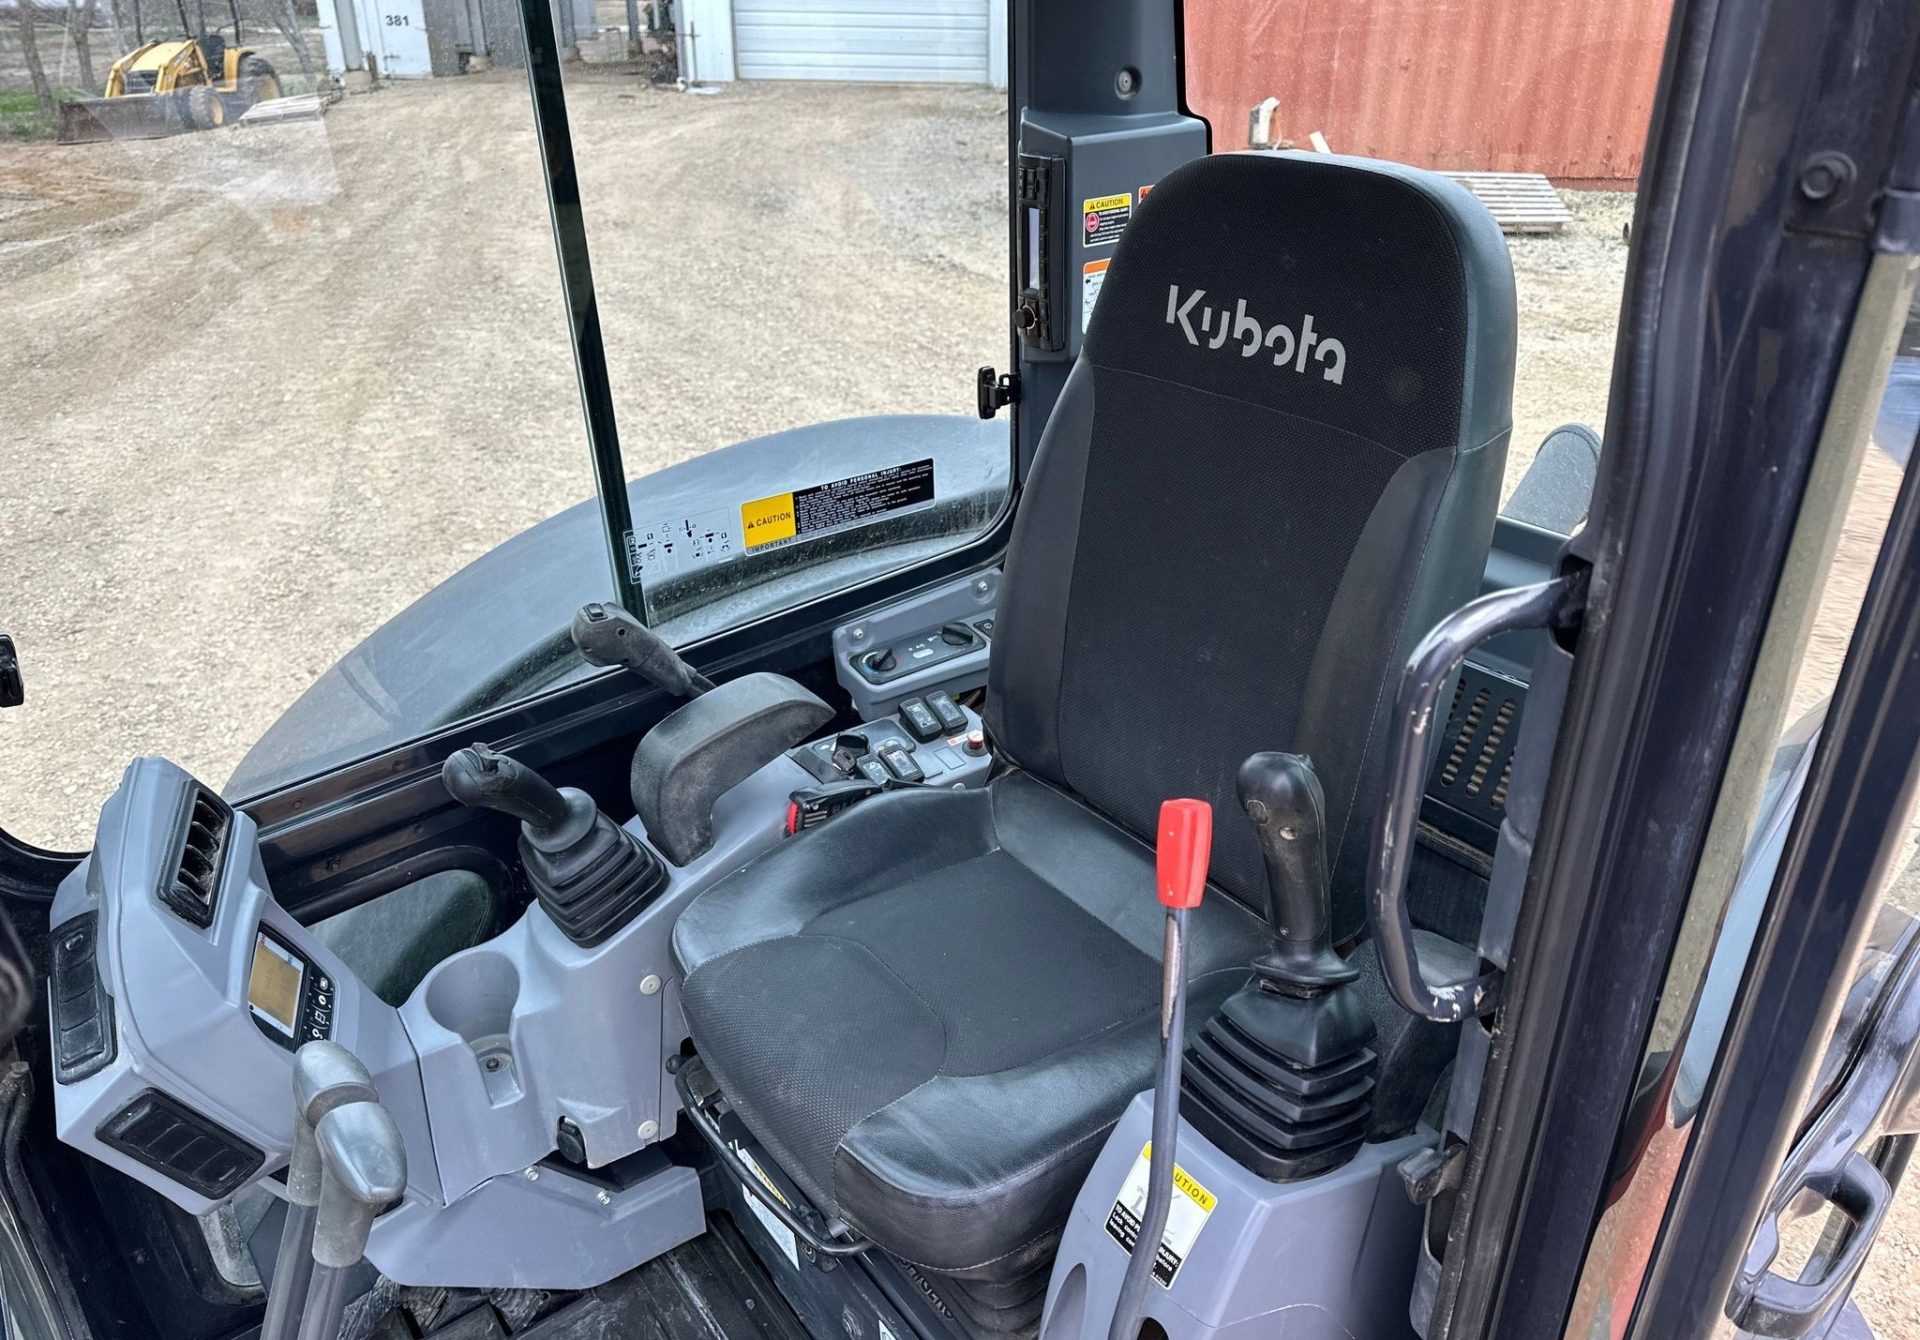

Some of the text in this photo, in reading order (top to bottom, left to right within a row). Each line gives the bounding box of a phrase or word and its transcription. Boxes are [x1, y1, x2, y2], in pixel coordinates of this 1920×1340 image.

[385, 14, 409, 27] 381
[1096, 198, 1123, 208] CAUTION
[1165, 284, 1346, 385] Kubota
[756, 512, 792, 527] CAUTION
[1174, 1172, 1208, 1205] UTION
